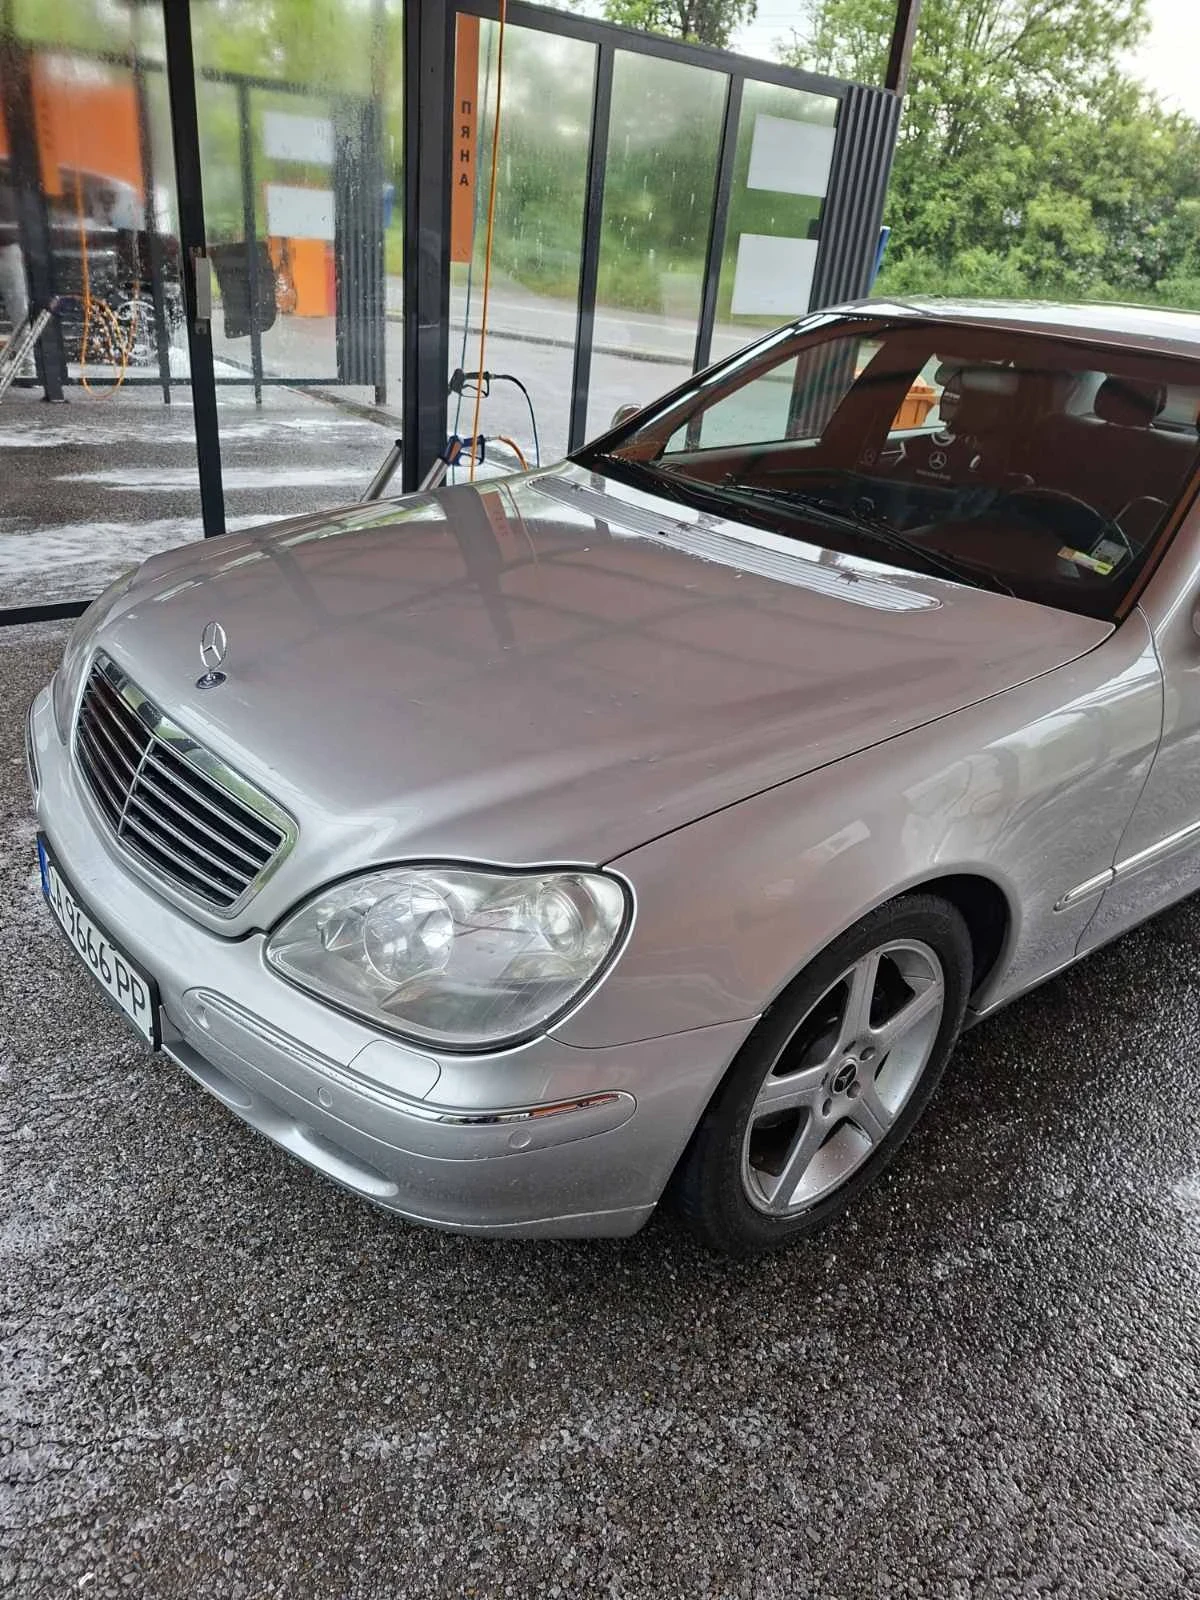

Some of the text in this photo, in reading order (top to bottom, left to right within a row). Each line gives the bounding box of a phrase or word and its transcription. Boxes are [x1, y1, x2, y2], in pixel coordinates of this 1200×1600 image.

[460, 101, 472, 187] ПЯНА
[66, 896, 111, 984] 9666
[115, 957, 145, 1017] PP
